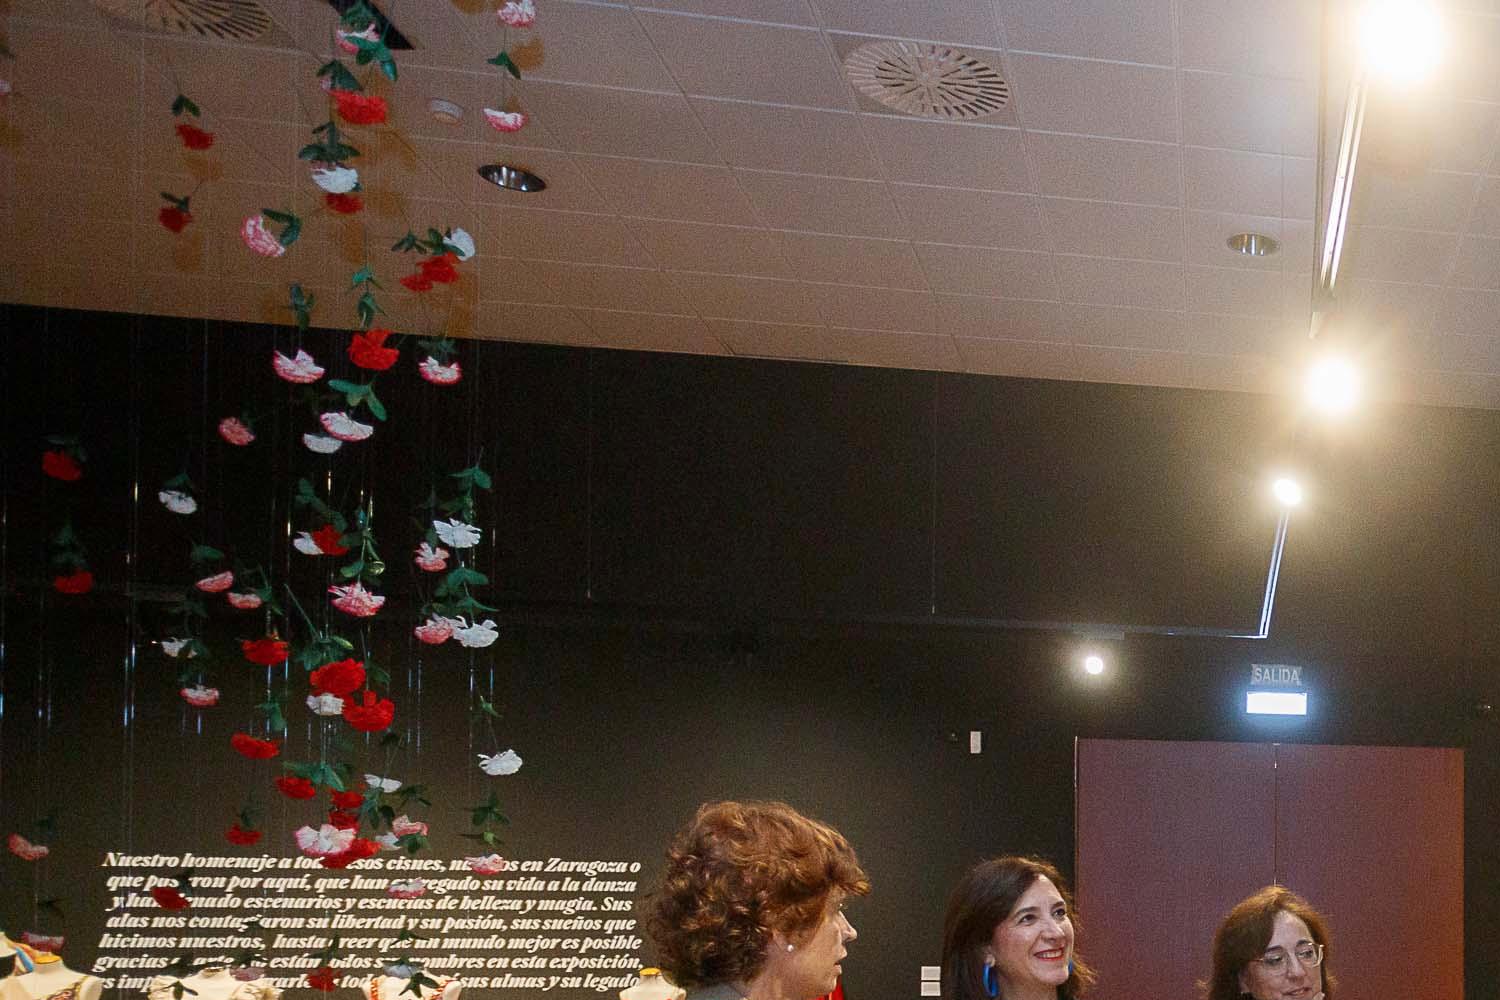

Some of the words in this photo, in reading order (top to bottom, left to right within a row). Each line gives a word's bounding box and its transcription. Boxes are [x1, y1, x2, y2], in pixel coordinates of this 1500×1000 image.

[1254, 667, 1299, 681] SALIDA
[102, 852, 179, 867] Nuestro
[180, 853, 278, 873] homenaje
[278, 857, 293, 869] a
[386, 856, 447, 872] cisnes,
[521, 860, 543, 872] en
[544, 858, 628, 876] Zaragoza
[630, 862, 641, 873] o
[106, 875, 144, 892] que
[142, 875, 227, 892] pasron
[224, 875, 262, 892] por
[263, 874, 311, 893] aquí,
[314, 876, 350, 893] que
[350, 875, 388, 889] han
[482, 880, 504, 890] su
[506, 877, 545, 891] vida
[547, 880, 560, 891] a
[561, 877, 580, 891] la
[582, 878, 637, 892] danza
[105, 896, 125, 911] y
[243, 895, 342, 909] escenarios
[337, 898, 357, 912] y
[358, 897, 434, 909] escuelas
[435, 896, 458, 909] de
[459, 896, 522, 910] belleza
[519, 900, 536, 914] y
[537, 897, 598, 915] magia.
[601, 897, 633, 911] Sus
[106, 913, 149, 927] alas
[151, 916, 187, 928] nos
[306, 917, 331, 928] su
[331, 914, 406, 929] libertad
[407, 918, 420, 930] y
[420, 918, 443, 929] su
[440, 914, 508, 933] pasión,
[510, 918, 541, 930] sus
[542, 916, 602, 930] sueños
[603, 919, 637, 934] que
[99, 934, 177, 948] hicimos
[178, 935, 266, 950] nuestros,
[272, 934, 328, 948] hasta
[327, 937, 379, 949] reer
[414, 938, 439, 949] un
[441, 935, 506, 949] mundo
[507, 935, 561, 953] mejor
[561, 938, 581, 949] es
[579, 935, 642, 953] posible
[92, 954, 168, 972] gracias
[329, 954, 373, 968] odos
[486, 958, 509, 968] en
[511, 956, 548, 968] esta
[460, 976, 491, 988] sus
[490, 974, 546, 988] almas
[542, 975, 560, 991] y
[560, 977, 582, 988] su
